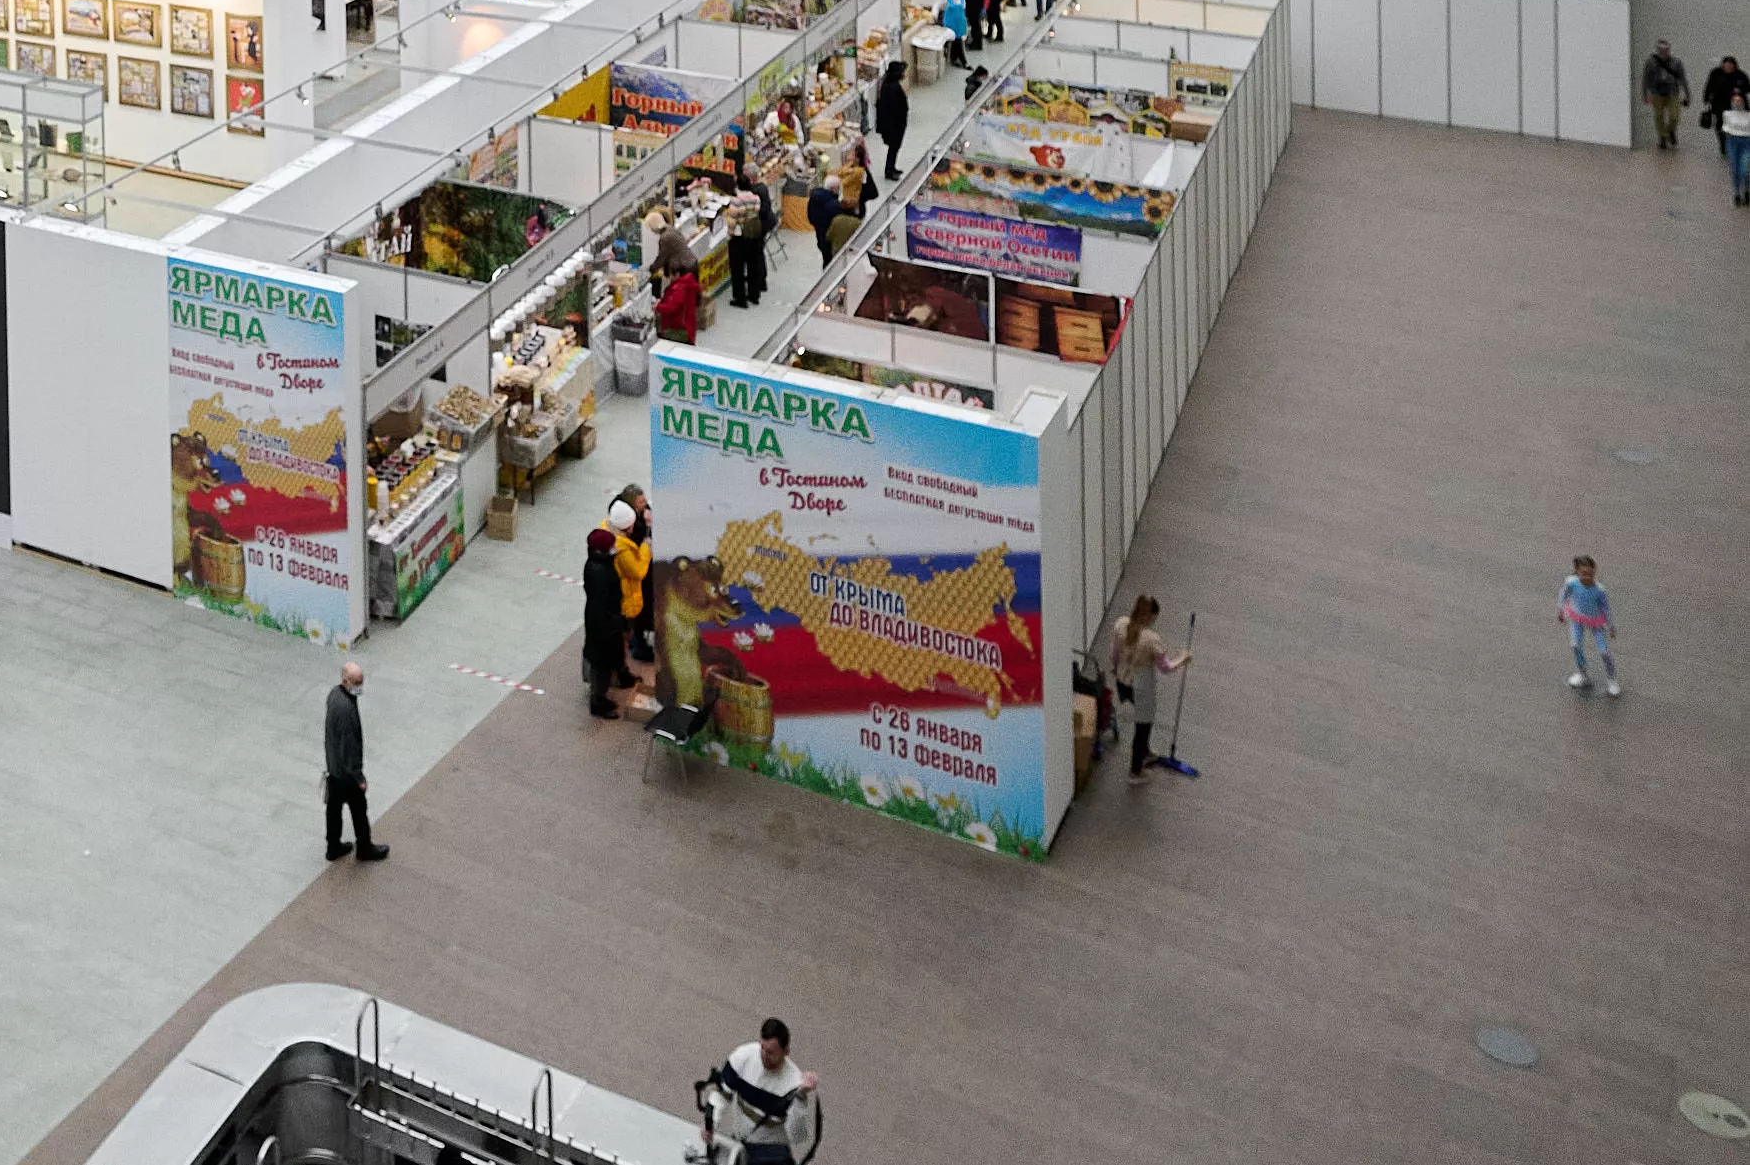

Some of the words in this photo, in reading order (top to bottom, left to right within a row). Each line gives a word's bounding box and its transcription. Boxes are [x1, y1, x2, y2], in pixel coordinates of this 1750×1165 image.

[612, 88, 703, 114] Горный
[938, 211, 1005, 233] горный
[913, 223, 1002, 250] Северной
[1007, 240, 1076, 263] Осетии
[170, 265, 336, 326] ЯРМАРКА
[172, 299, 267, 344] МЕДА
[266, 352, 339, 371] Гостином
[279, 373, 325, 394] Дворе
[661, 366, 872, 441] ЯРМАРКА
[662, 403, 784, 459] МЕДА
[771, 467, 868, 490] Гостином
[788, 491, 847, 516] Дворе
[267, 527, 284, 549] 26
[269, 554, 283, 576] 13
[810, 571, 828, 597] ОТ
[834, 577, 907, 616] КРЫМА
[829, 602, 853, 627] ДО
[859, 608, 1002, 670] ВЛАДИВОСТОКА
[889, 708, 909, 732] 26
[889, 735, 908, 759] 13
